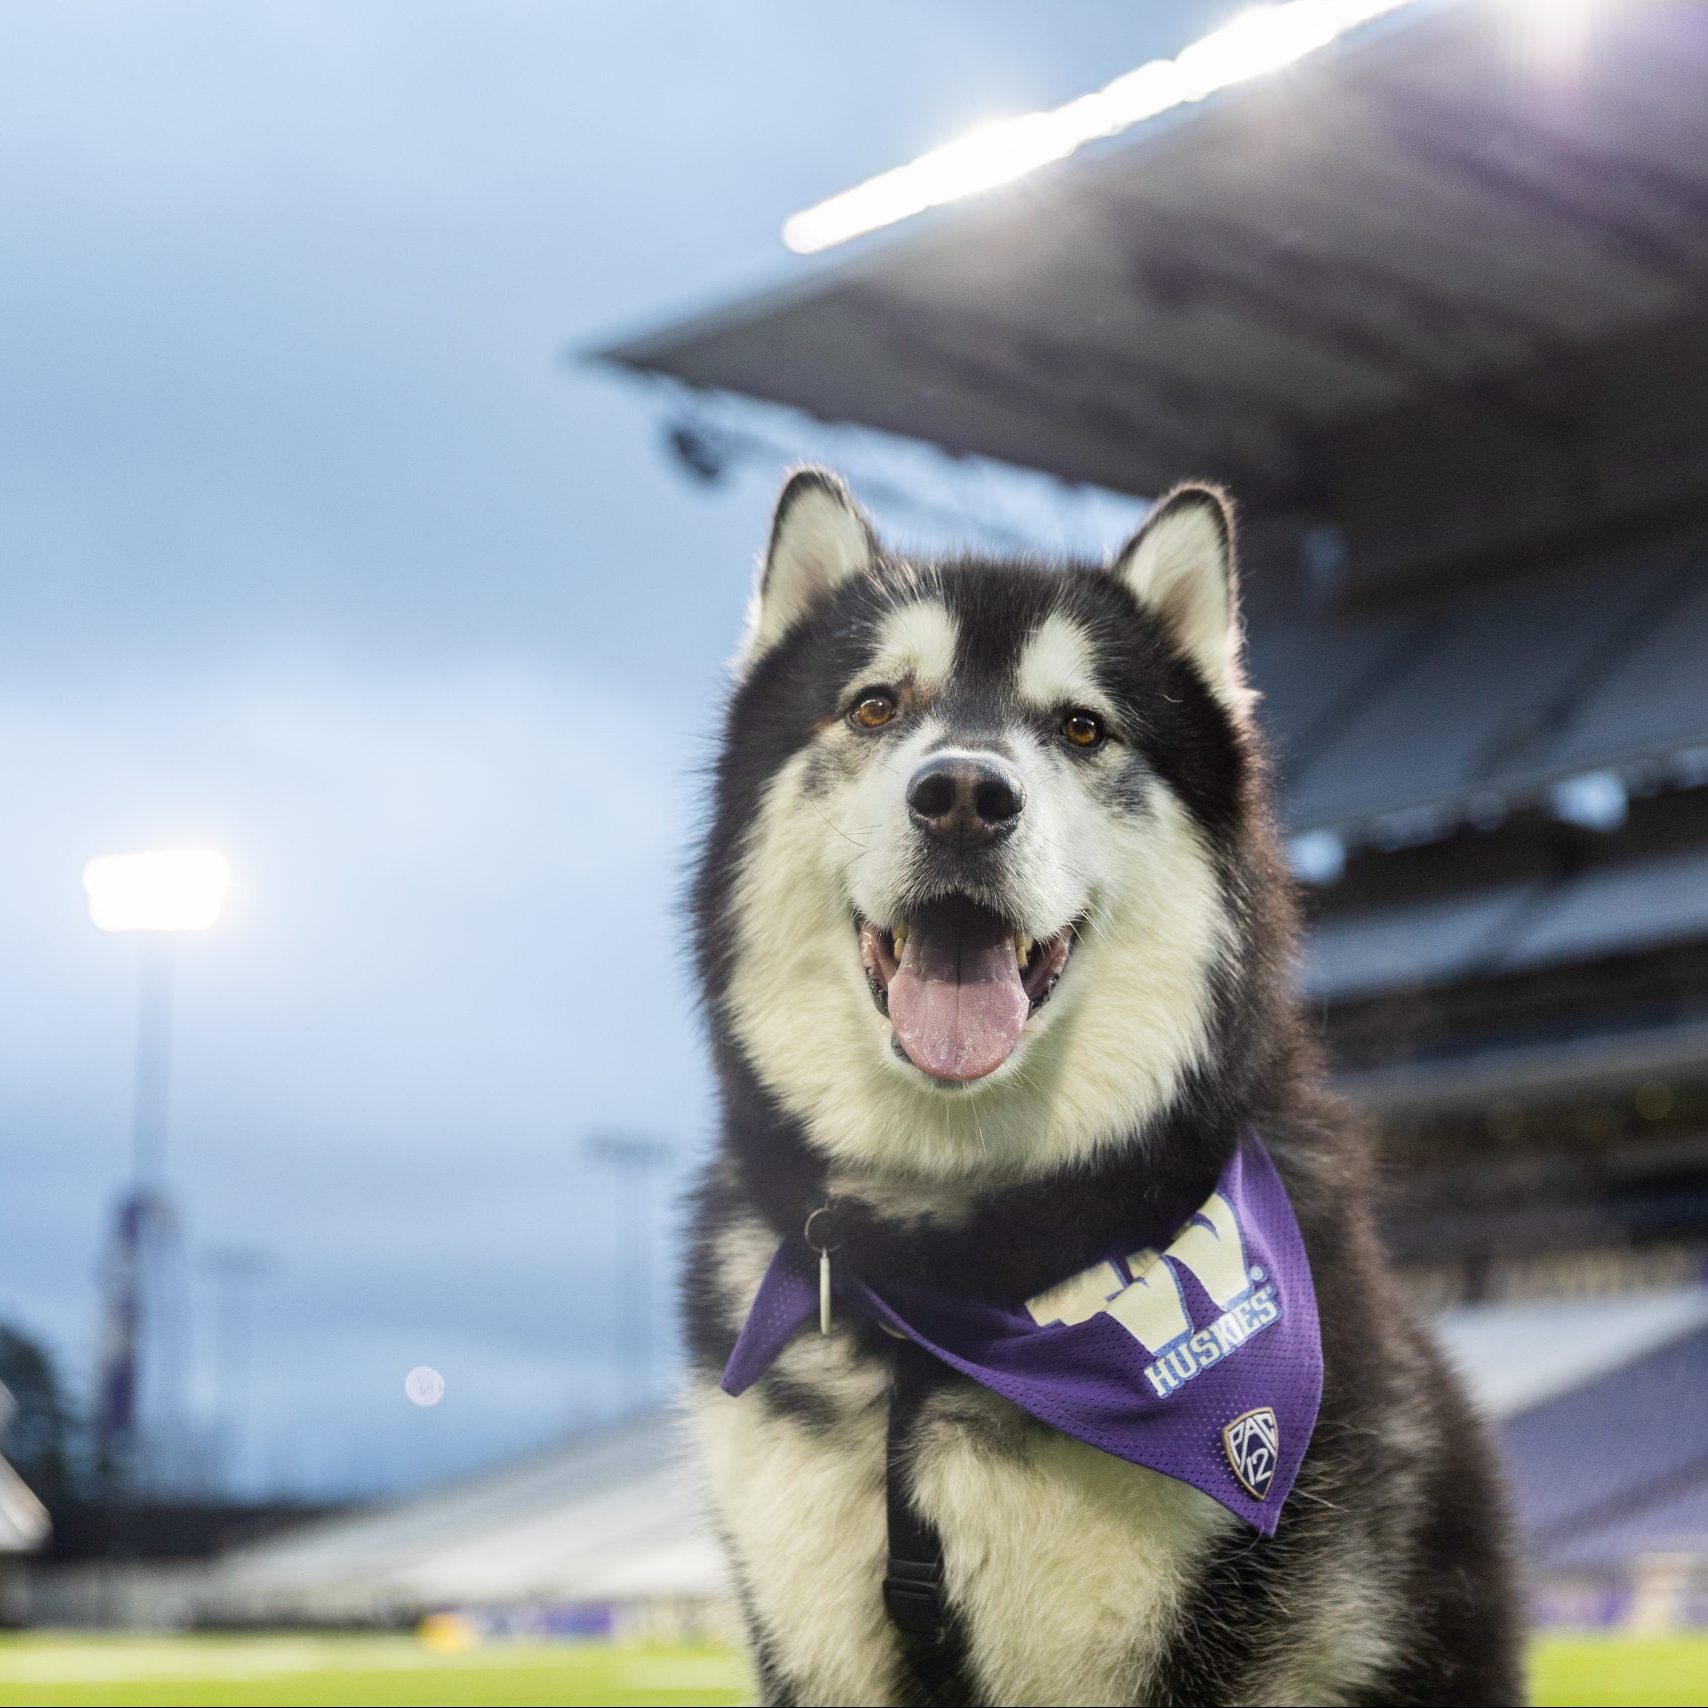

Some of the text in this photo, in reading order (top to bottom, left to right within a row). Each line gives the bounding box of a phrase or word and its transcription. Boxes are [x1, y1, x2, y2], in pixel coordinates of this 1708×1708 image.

[1143, 1289, 1281, 1398] HUSKIES
[1228, 1412, 1277, 1474] PAC
[1246, 1447, 1273, 1486] 12
